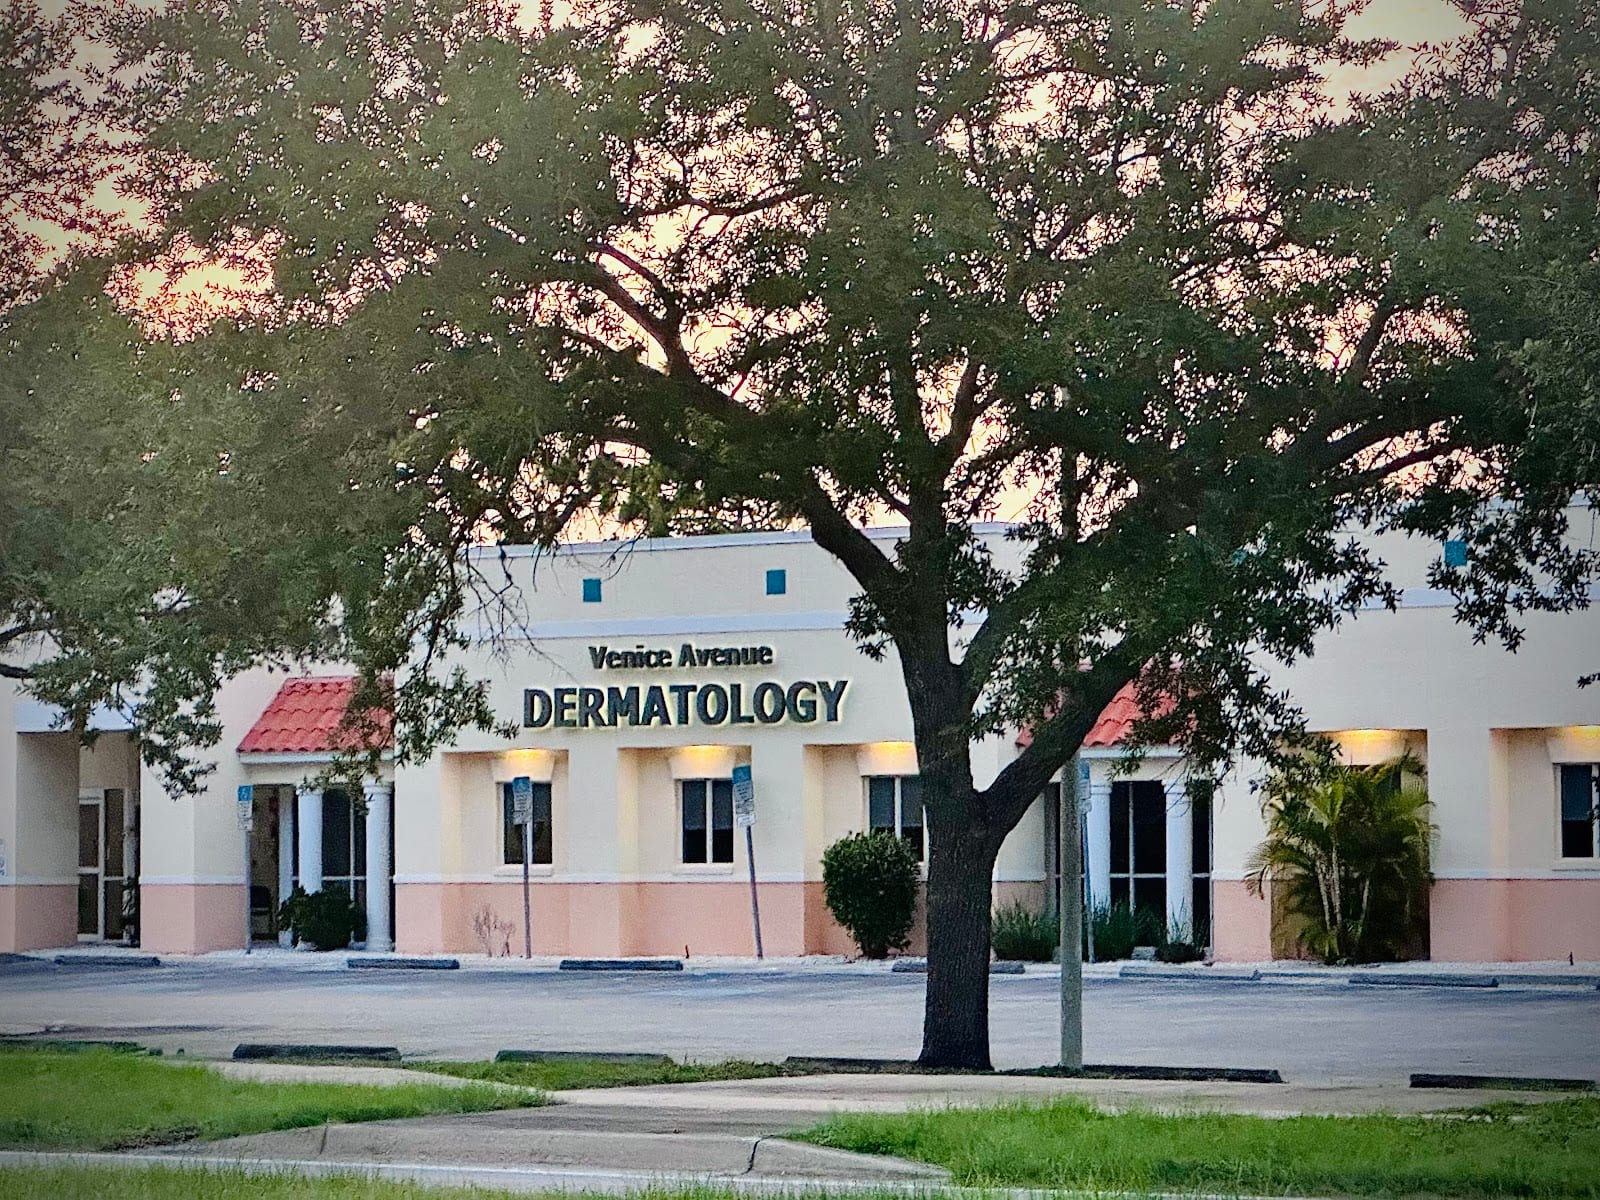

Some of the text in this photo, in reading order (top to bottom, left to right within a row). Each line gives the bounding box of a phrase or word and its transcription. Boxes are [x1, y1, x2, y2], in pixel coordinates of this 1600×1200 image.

[589, 643, 773, 669] Venice Avenue
[524, 680, 848, 728] DERMATOLOGY
